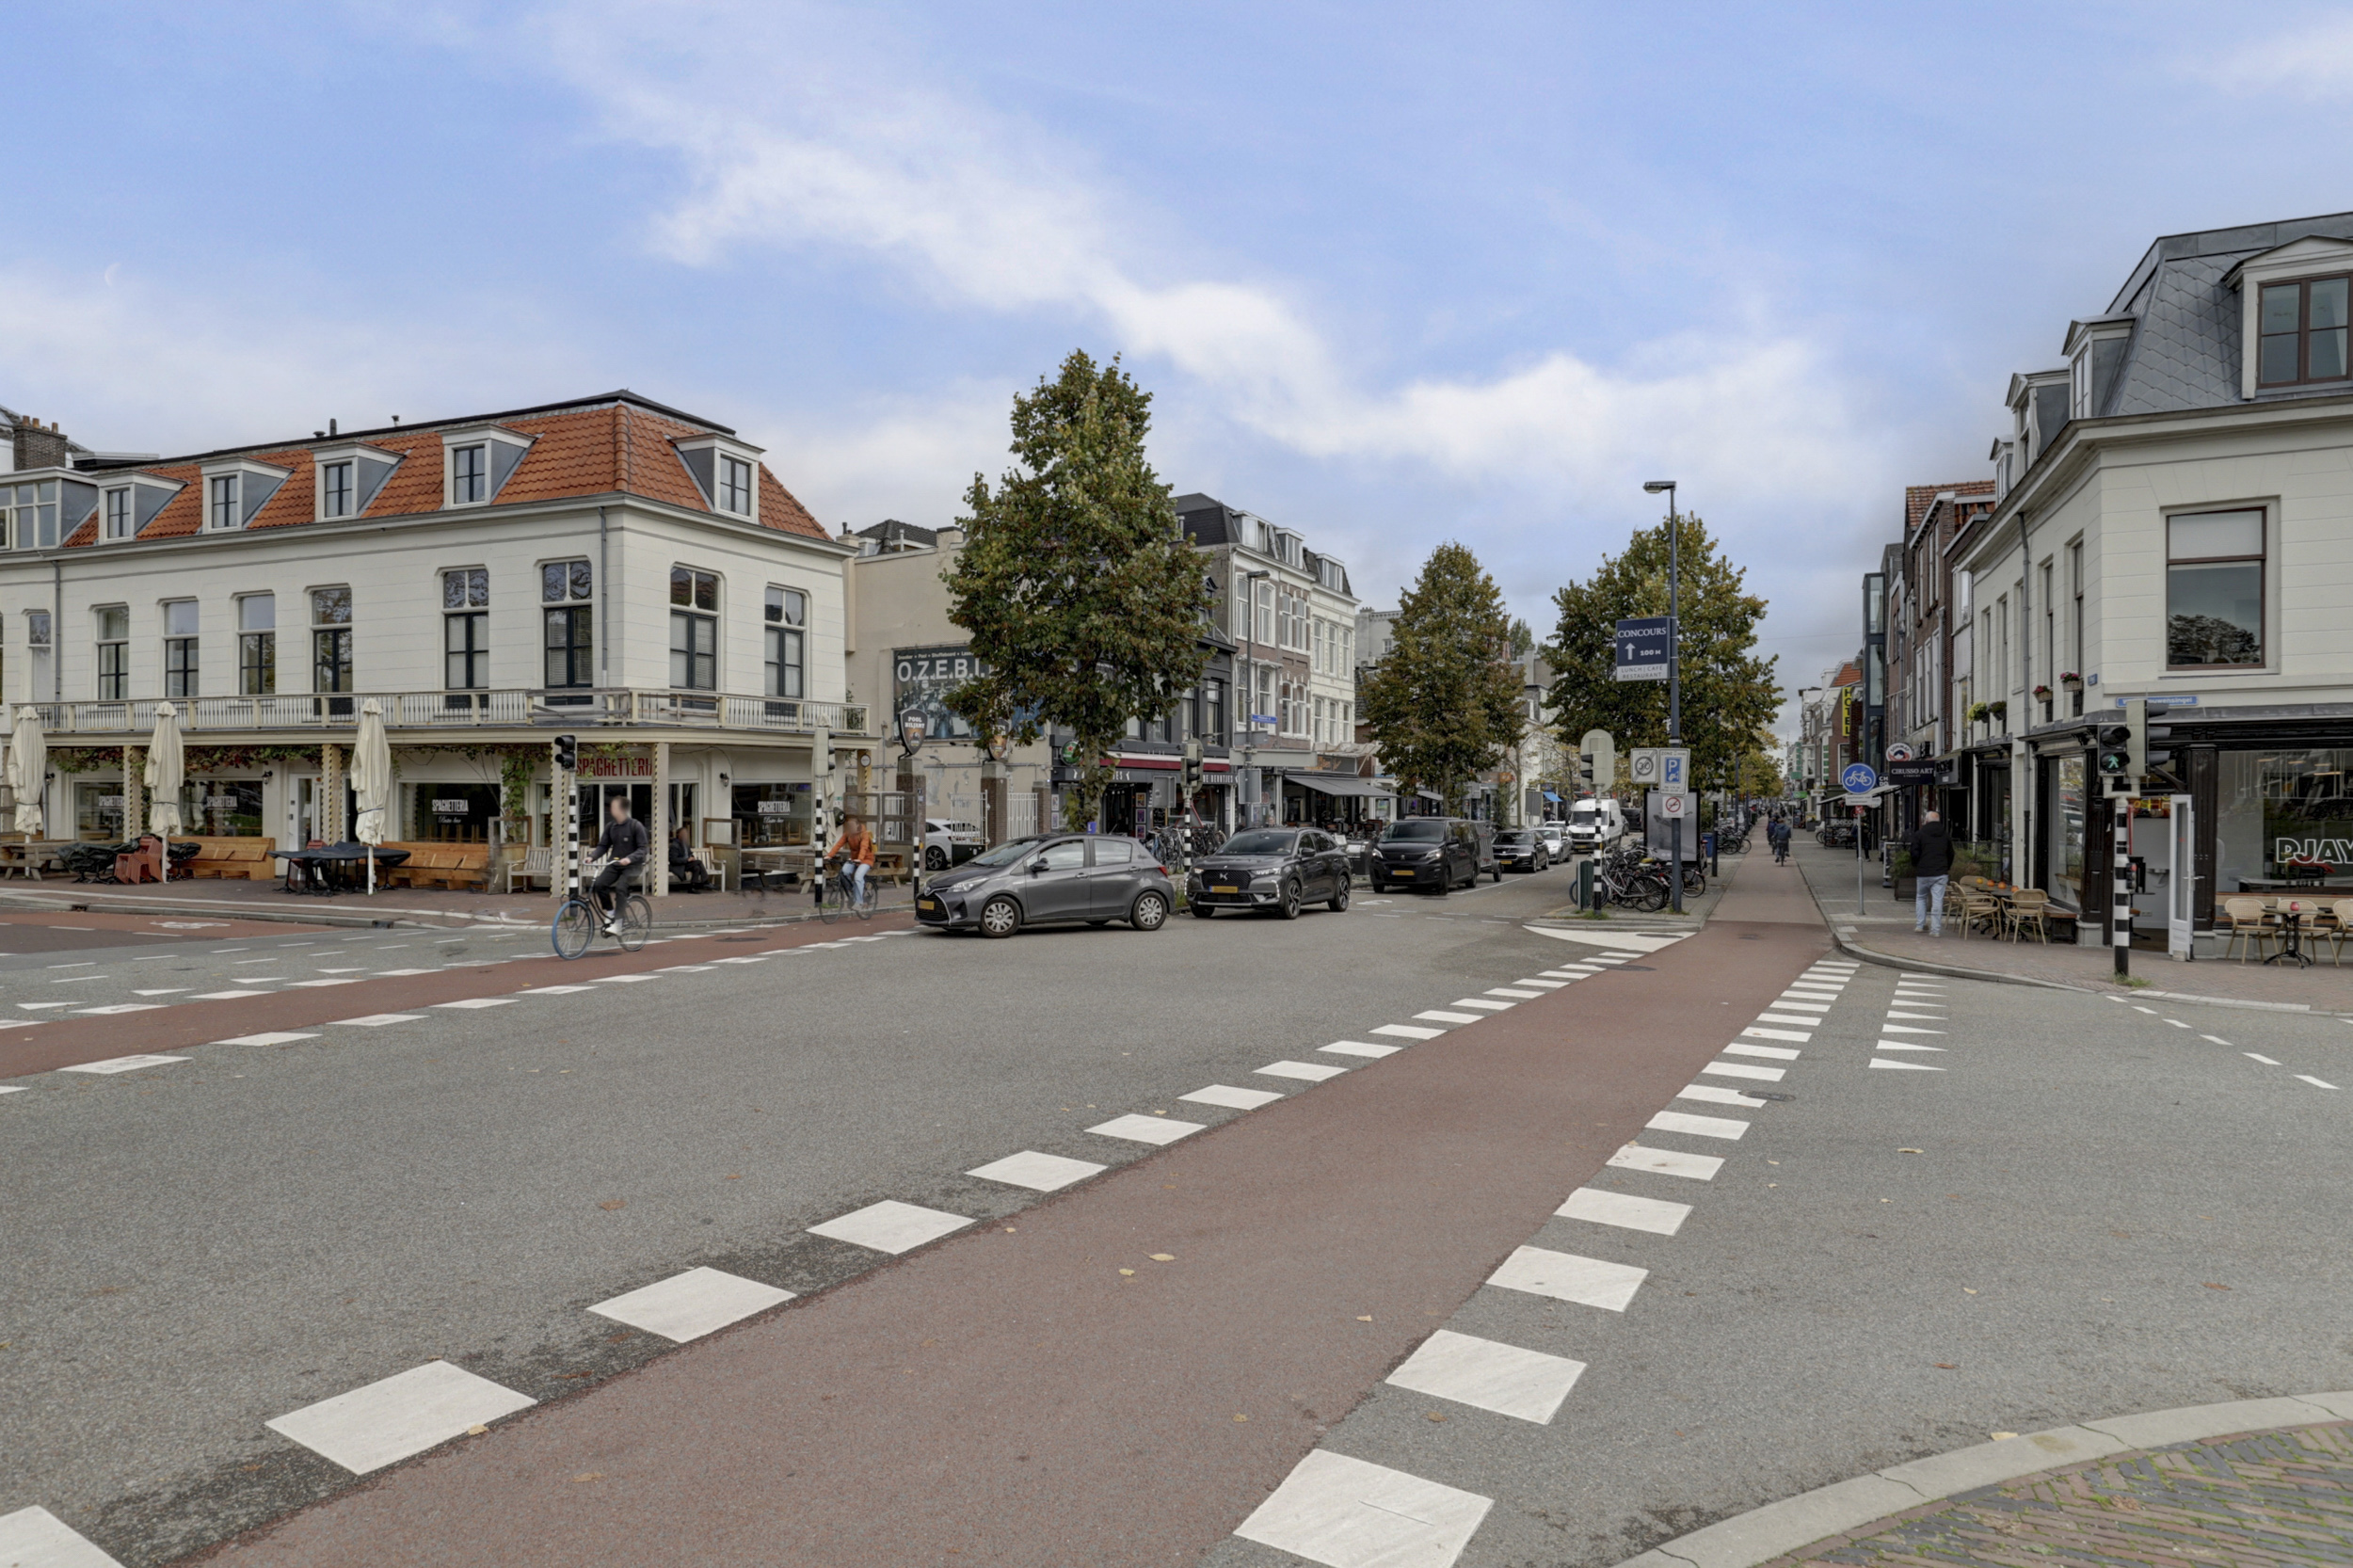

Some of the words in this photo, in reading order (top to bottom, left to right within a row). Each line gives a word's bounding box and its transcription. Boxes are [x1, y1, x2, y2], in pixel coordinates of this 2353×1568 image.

[1617, 627, 1667, 638] CONCOURS
[1844, 688, 1852, 735] HOTEL
[1638, 761, 1651, 771] 30
[99, 795, 123, 807] SPAGHETTER
[206, 795, 238, 808] SPAGHETTERIA
[432, 799, 469, 812] SPAGHETTERIA
[758, 801, 791, 813] SPAGHETTERIA
